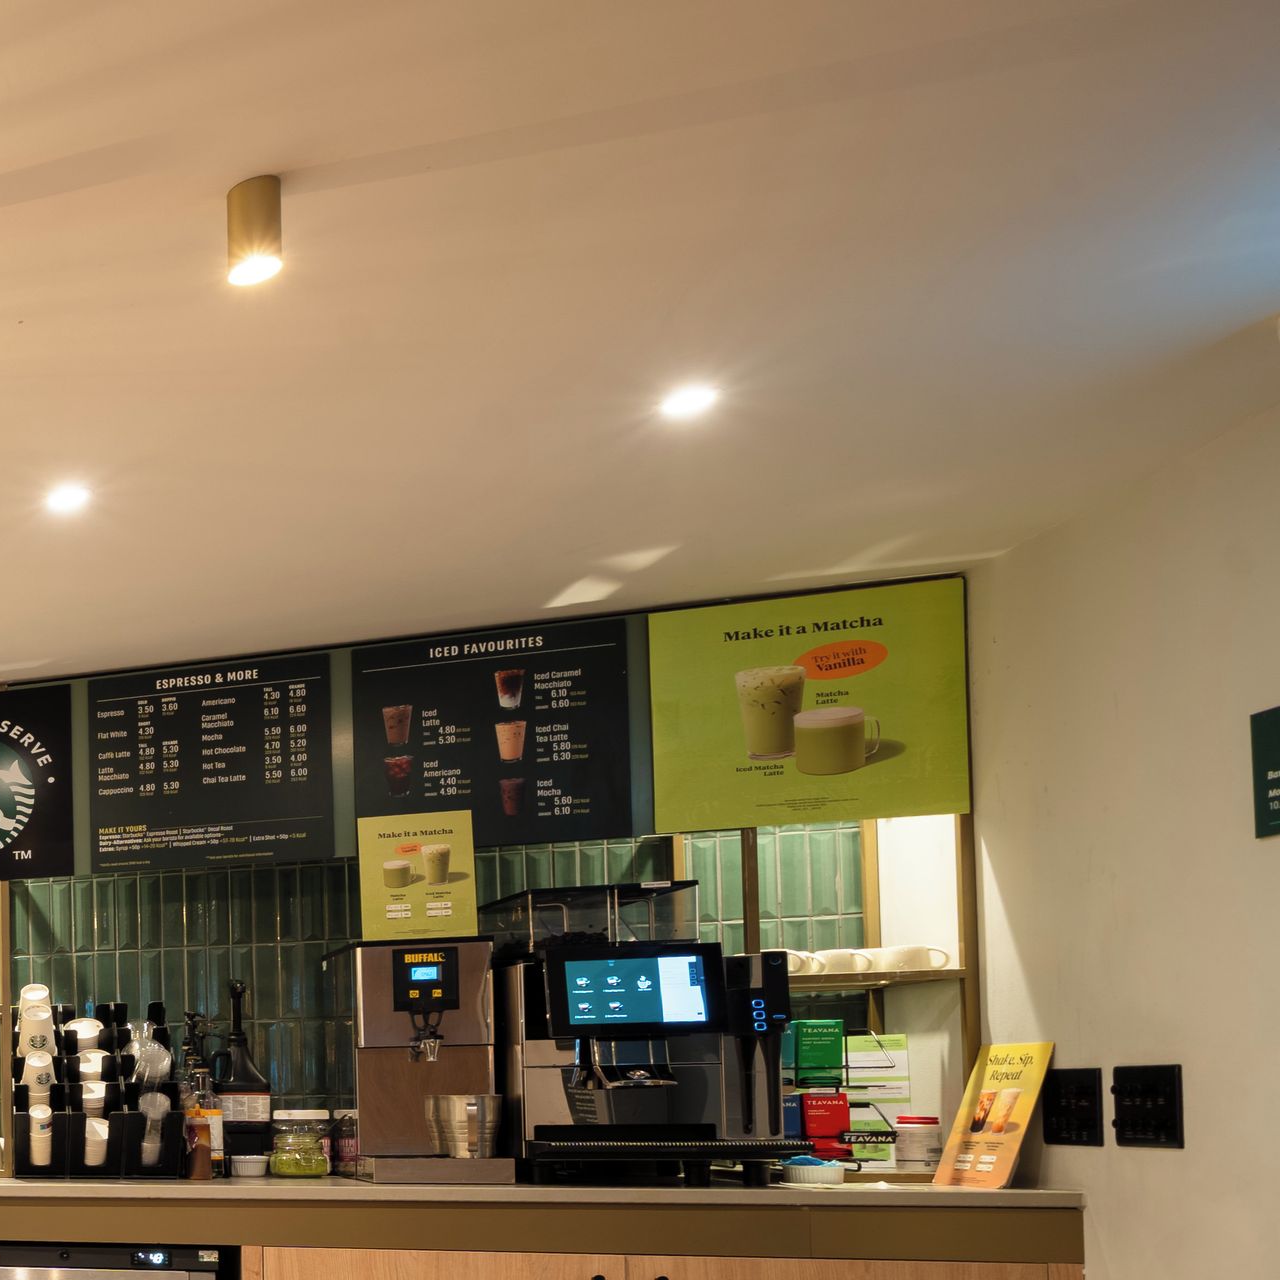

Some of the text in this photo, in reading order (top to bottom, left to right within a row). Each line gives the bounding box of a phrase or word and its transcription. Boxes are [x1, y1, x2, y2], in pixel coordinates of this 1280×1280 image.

[724, 616, 884, 642] Make it a Matcha
[429, 636, 543, 659] ICED FAVOURITES
[841, 646, 867, 659] with
[815, 656, 865, 673] Vanilla
[156, 669, 259, 690] ESPRESSO & MORE
[534, 669, 581, 680] Iced Caramel
[534, 681, 572, 690] Macchiato
[201, 688, 306, 706] Americano 4.30 4.80
[551, 688, 567, 698] 6.10
[815, 689, 849, 698] Matcha
[551, 699, 570, 708] 6.60
[97, 709, 125, 718] Espresso
[138, 705, 154, 714] 3.50
[162, 702, 178, 711] 3.60
[201, 704, 306, 721] Caramel 6.10 6.60
[421, 709, 437, 717] Iced
[201, 720, 234, 729] Macchiato
[422, 718, 440, 727] Latte
[110, 730, 127, 738] White
[138, 726, 154, 735] 4.30
[202, 724, 306, 741] Mocha 5.50 6.00
[438, 725, 456, 734] 4.80
[535, 723, 569, 733] Iced Chai
[438, 735, 456, 745] 5.30
[536, 733, 568, 743] Tea Latte
[202, 738, 307, 756] Hot Chocolate 4.70 5.20
[552, 741, 571, 751] 5.80
[115, 750, 131, 758] Latte
[139, 747, 155, 756] 4.80
[162, 745, 179, 754] 5.30
[553, 752, 571, 761] 6.30
[139, 761, 155, 770] 4.80
[162, 759, 179, 768] 5.30
[202, 753, 307, 770] Hot Tea 3.50 4.00
[423, 760, 438, 768] Iced
[754, 763, 784, 772] Matcha
[98, 773, 130, 781] Macchiato
[202, 767, 308, 784] Chai Tea Latte 5.50 6.00
[423, 768, 461, 778] Americano
[439, 777, 456, 786] 4.40
[537, 779, 552, 787] Iced
[98, 781, 180, 796] Cappuccino 4.80 5.30
[439, 786, 457, 796] 4.90
[537, 788, 561, 797] Mocha
[554, 796, 572, 805] 5.60
[554, 806, 570, 816] 6.10
[98, 826, 117, 835] MAKE
[125, 824, 147, 833] YOURS
[420, 828, 453, 836] Matcha
[12, 849, 32, 860] TM
[989, 1069, 1023, 1083] Repeat
[843, 1135, 893, 1143] TEAVANA
